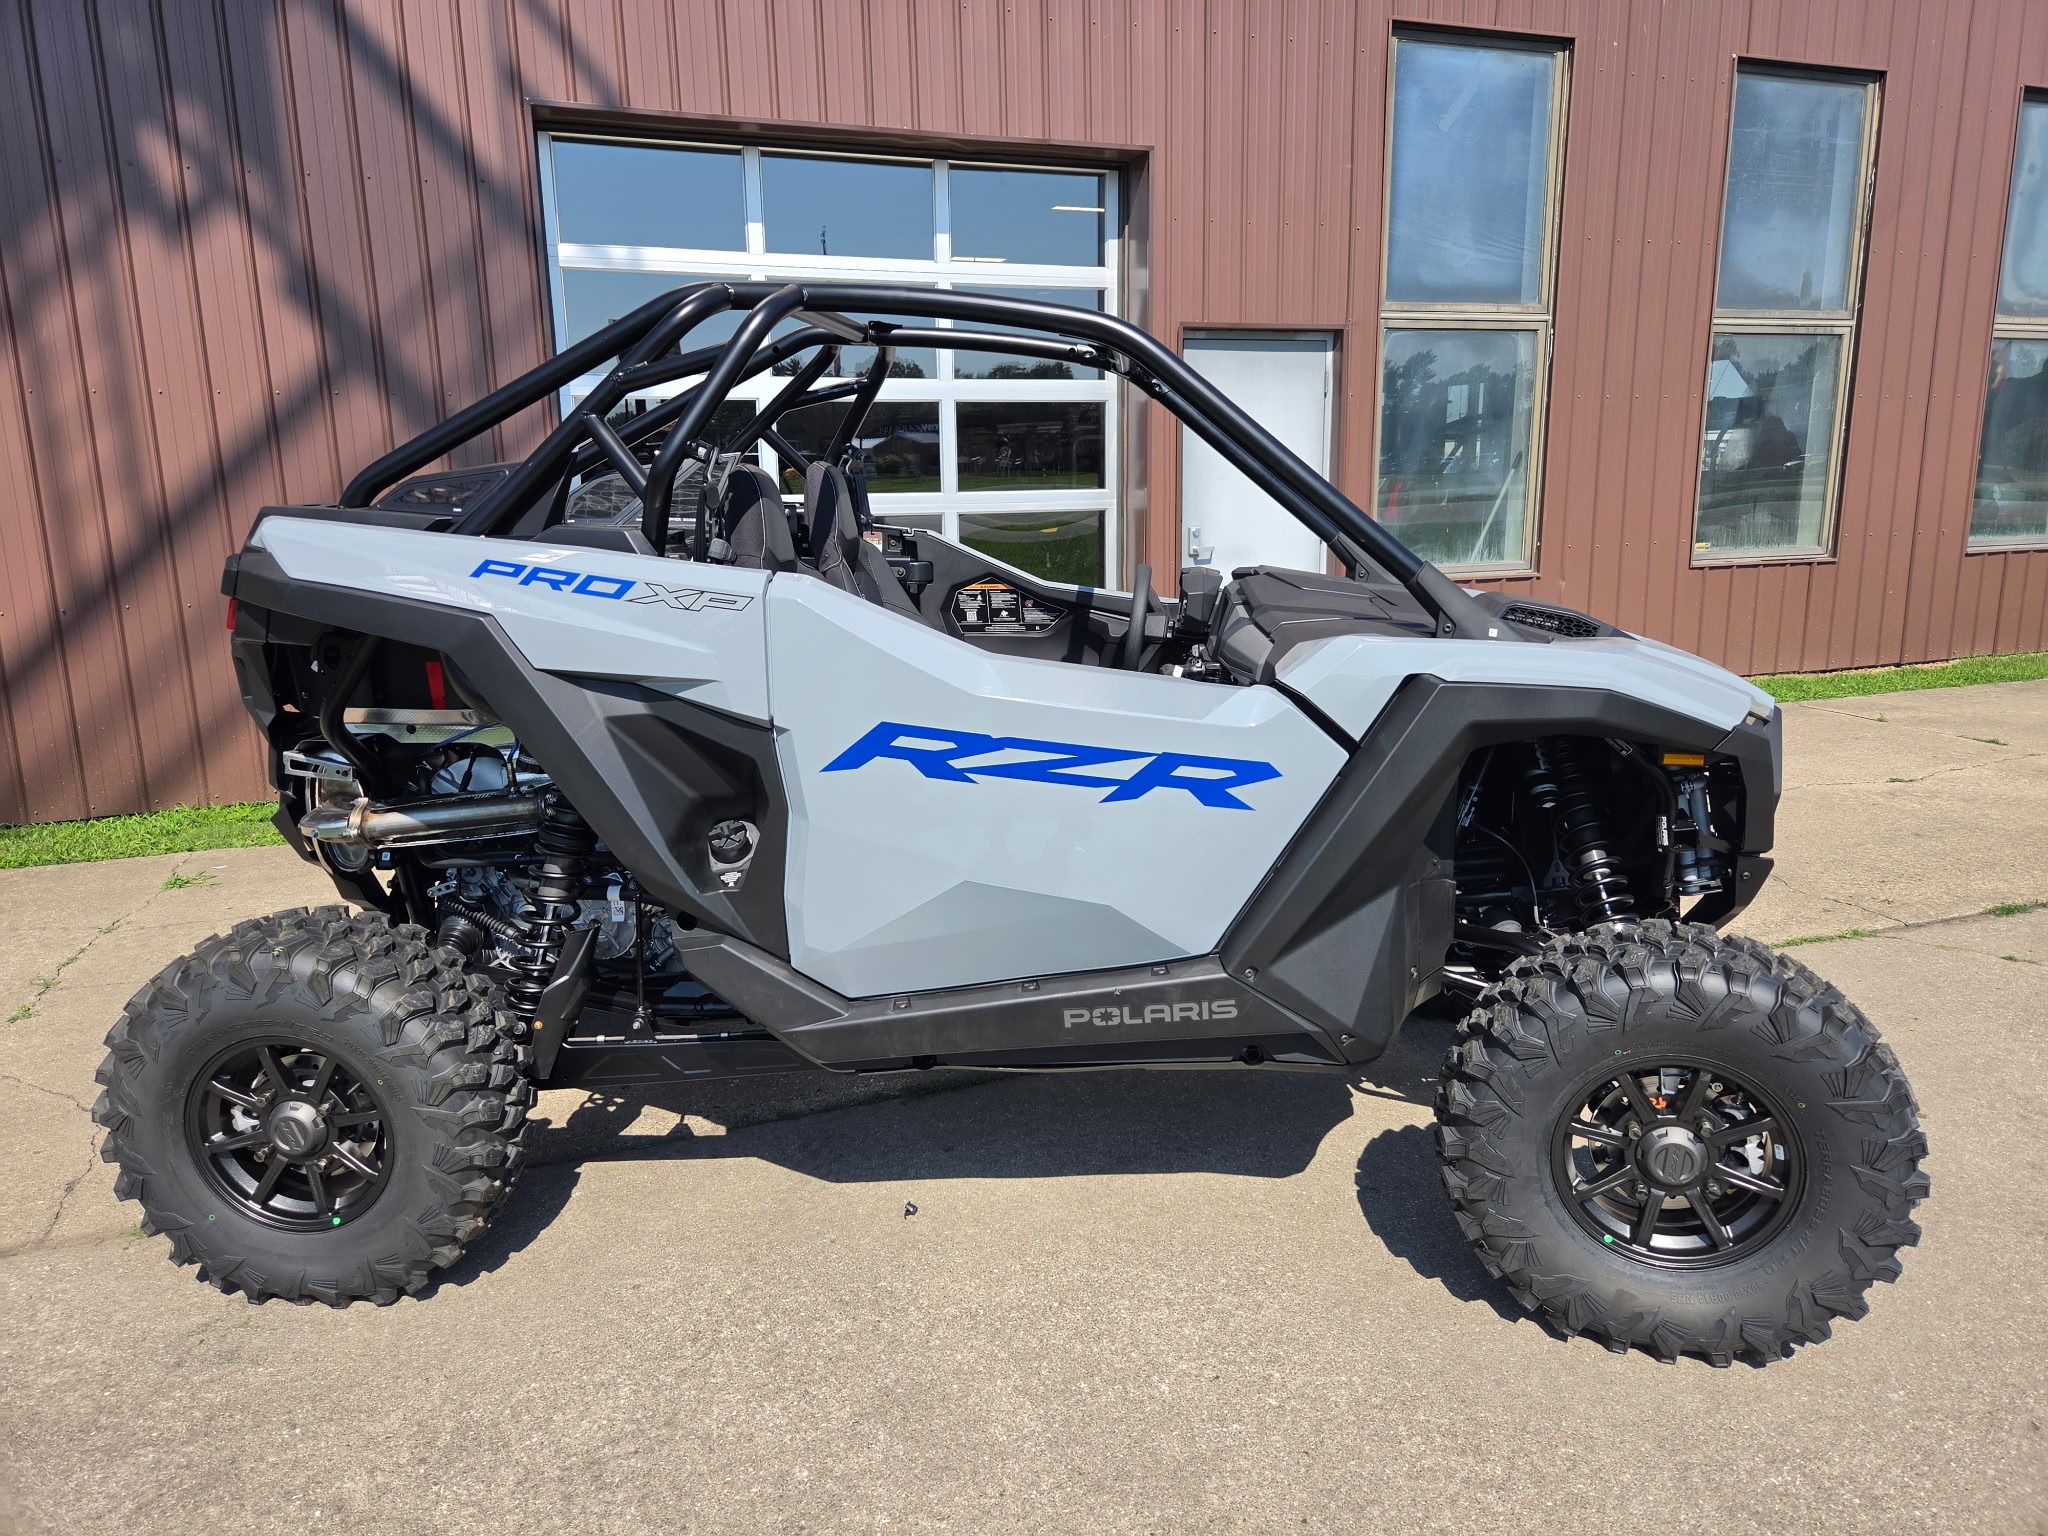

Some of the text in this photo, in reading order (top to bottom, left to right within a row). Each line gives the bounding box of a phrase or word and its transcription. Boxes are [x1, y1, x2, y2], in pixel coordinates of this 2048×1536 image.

[469, 559, 754, 612] PRO XP
[819, 721, 1283, 811] RZR
[1063, 999, 1239, 1028] POLARIS
